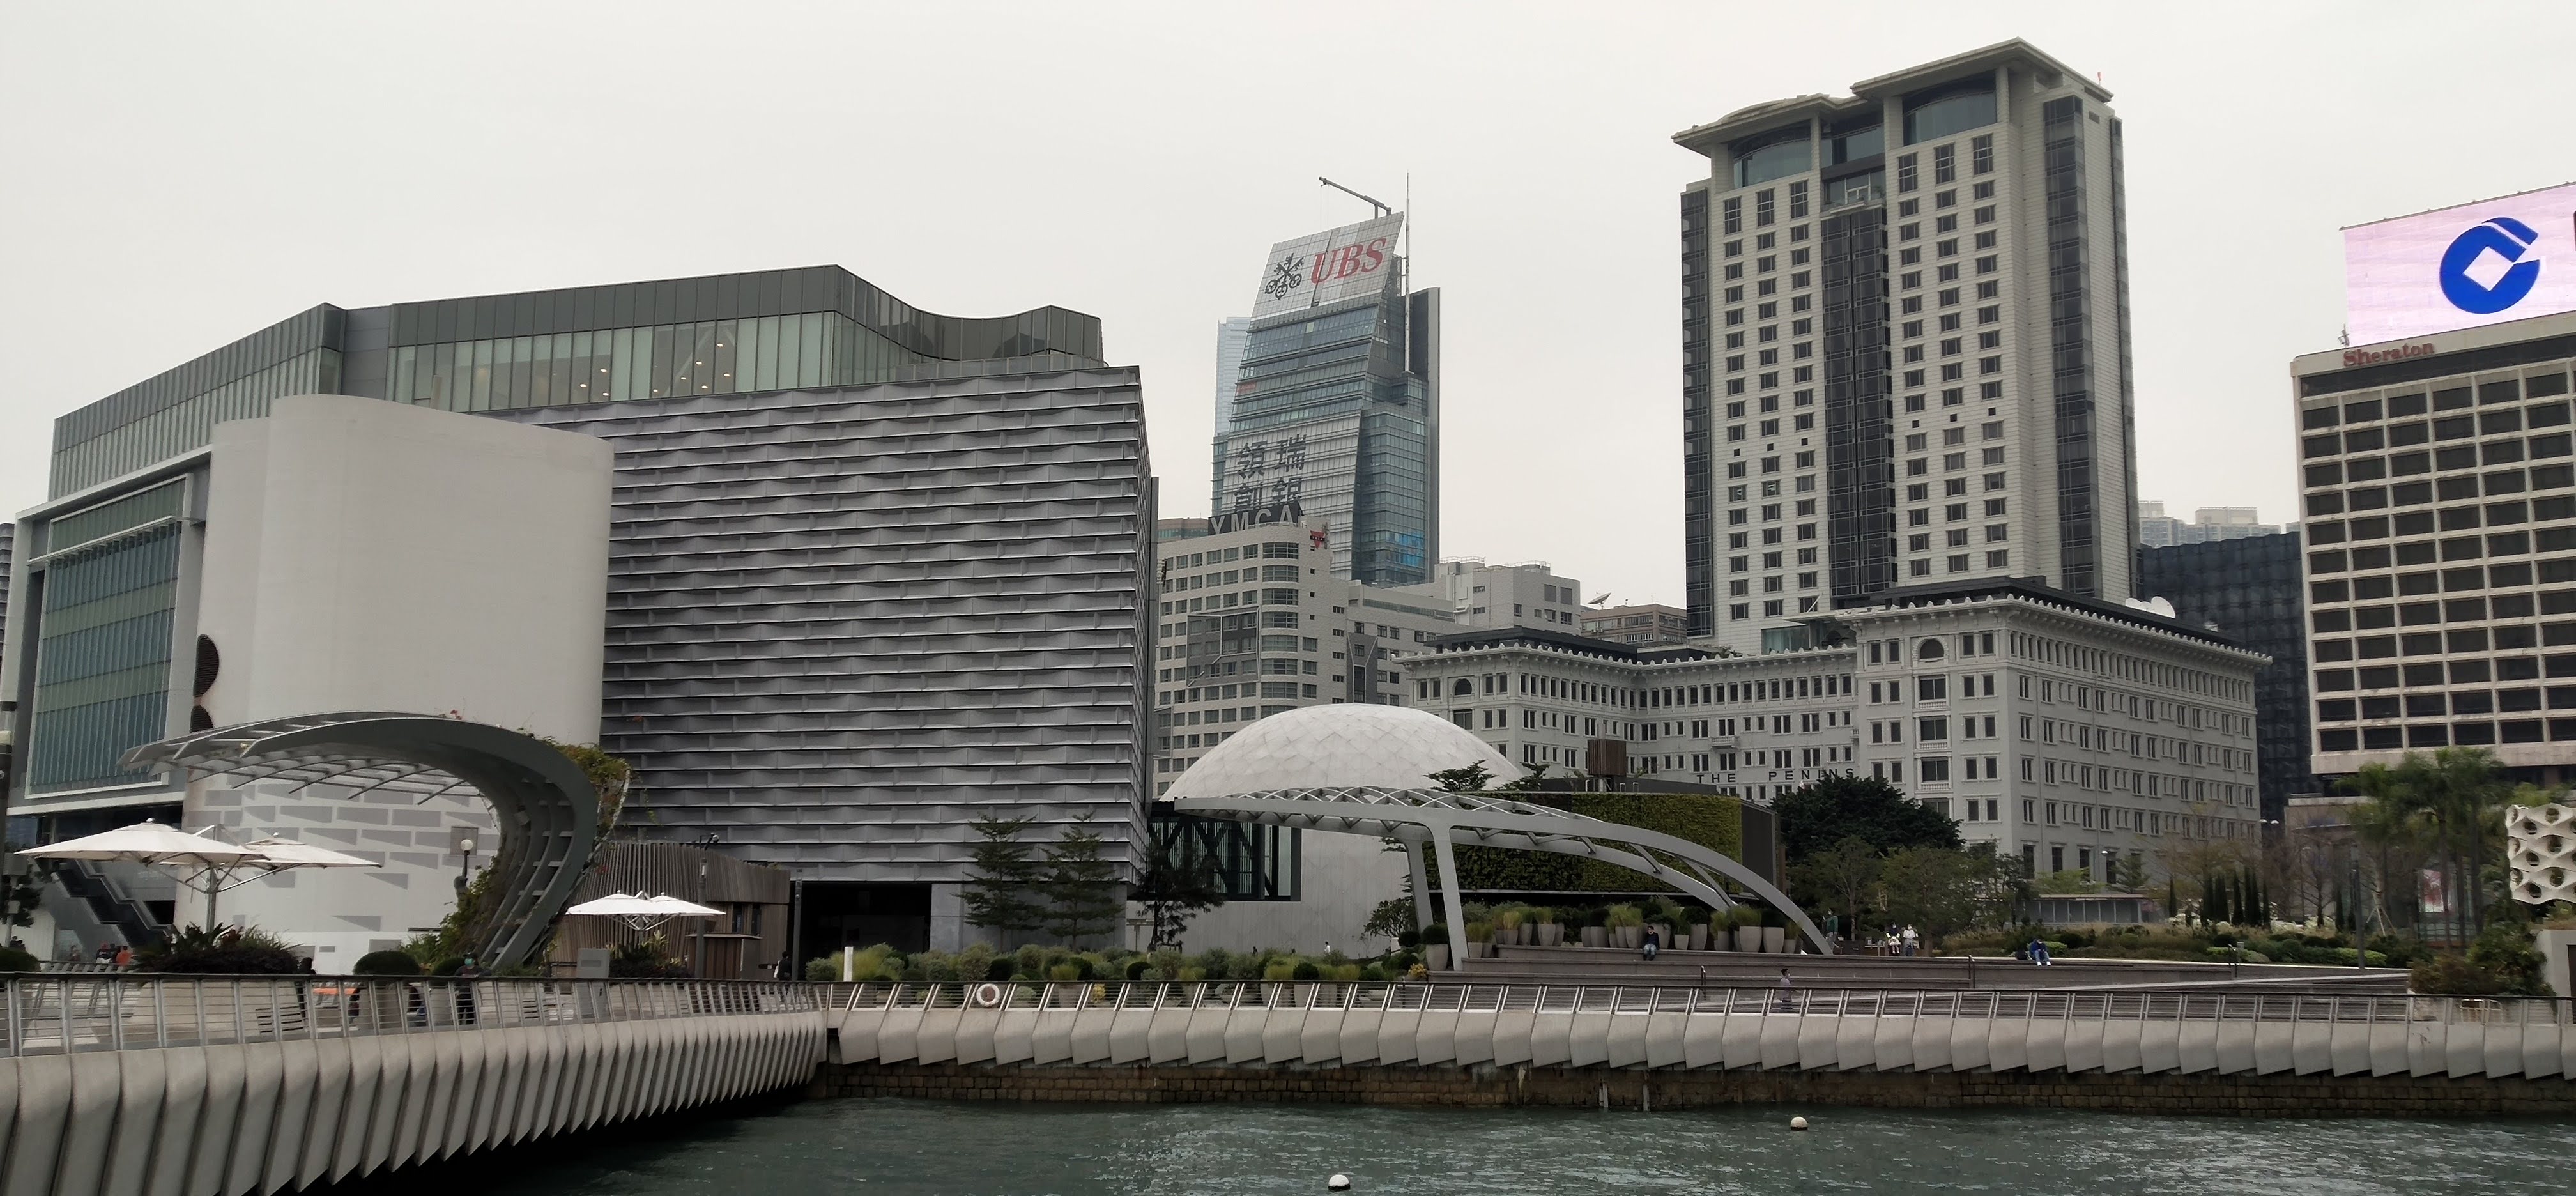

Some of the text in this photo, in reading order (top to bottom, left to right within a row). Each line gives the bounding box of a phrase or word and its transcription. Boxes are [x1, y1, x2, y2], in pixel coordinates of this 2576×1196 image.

[1311, 238, 1386, 284] UBS
[2343, 343, 2435, 367] Sheraton
[1271, 433, 1307, 504] 瑞銀
[1210, 505, 1294, 535] YMCA
[1696, 773, 1736, 783] THE
